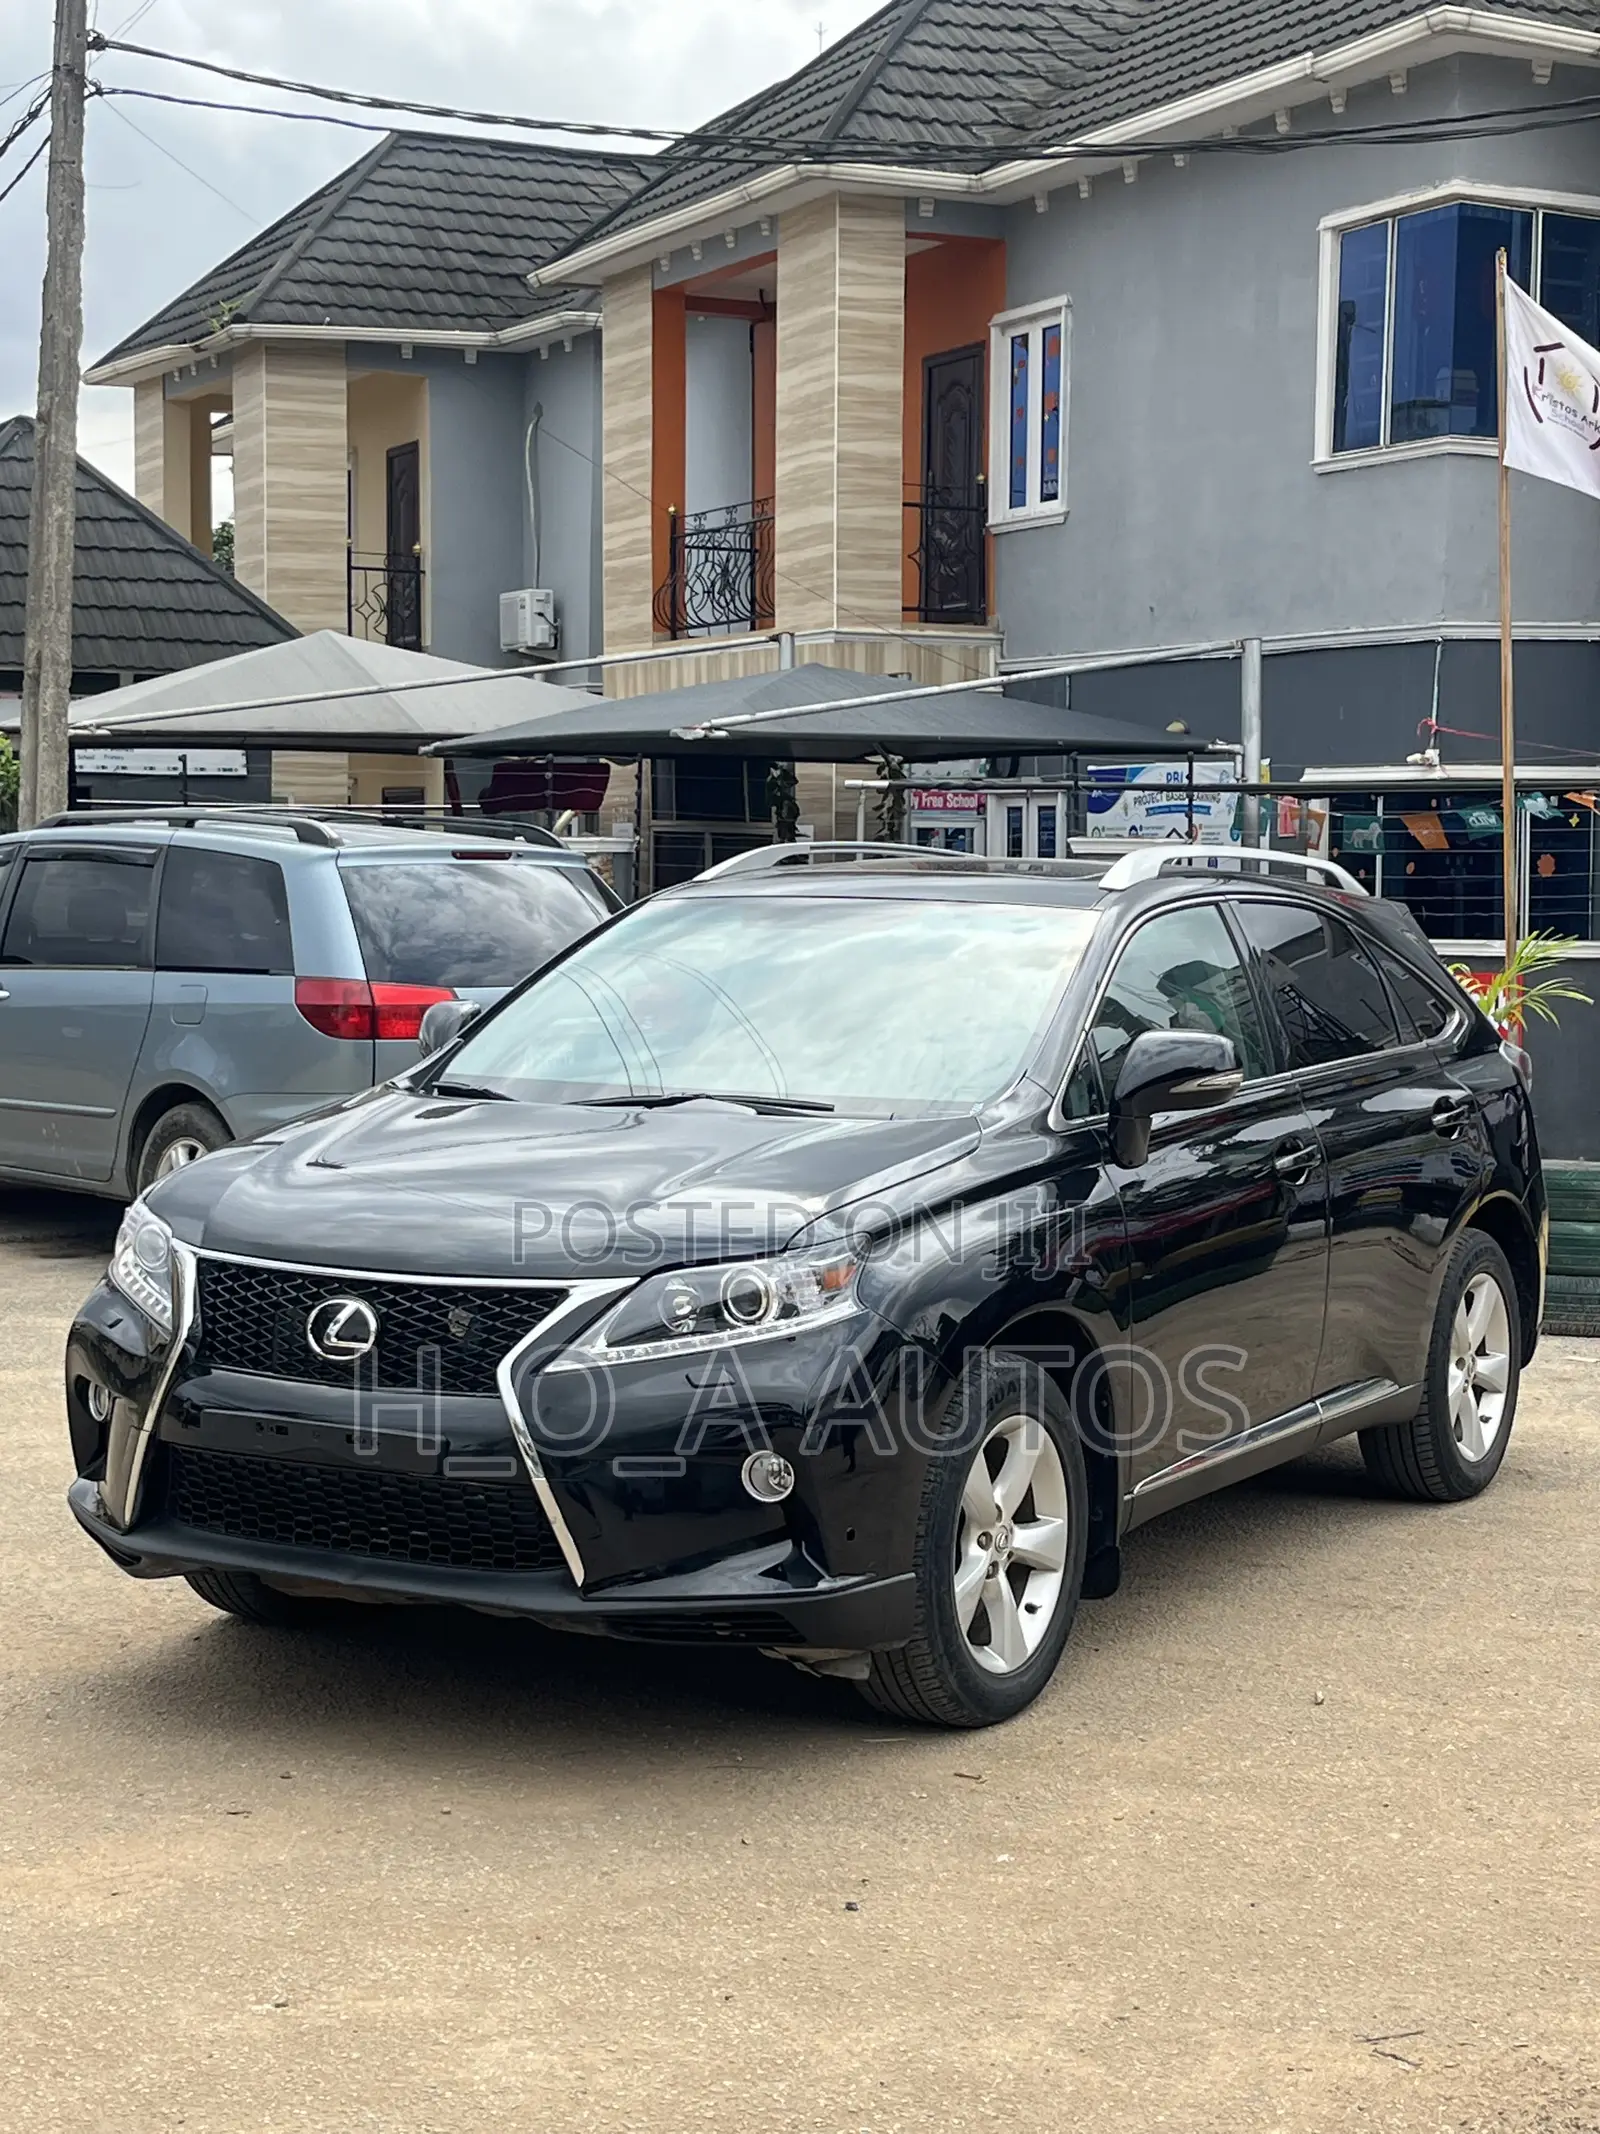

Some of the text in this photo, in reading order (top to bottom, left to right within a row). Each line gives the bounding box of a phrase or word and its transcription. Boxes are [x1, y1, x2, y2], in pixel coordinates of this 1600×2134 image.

[922, 793, 943, 808] Free
[947, 793, 978, 808] School
[1133, 792, 1163, 806] PROJECT
